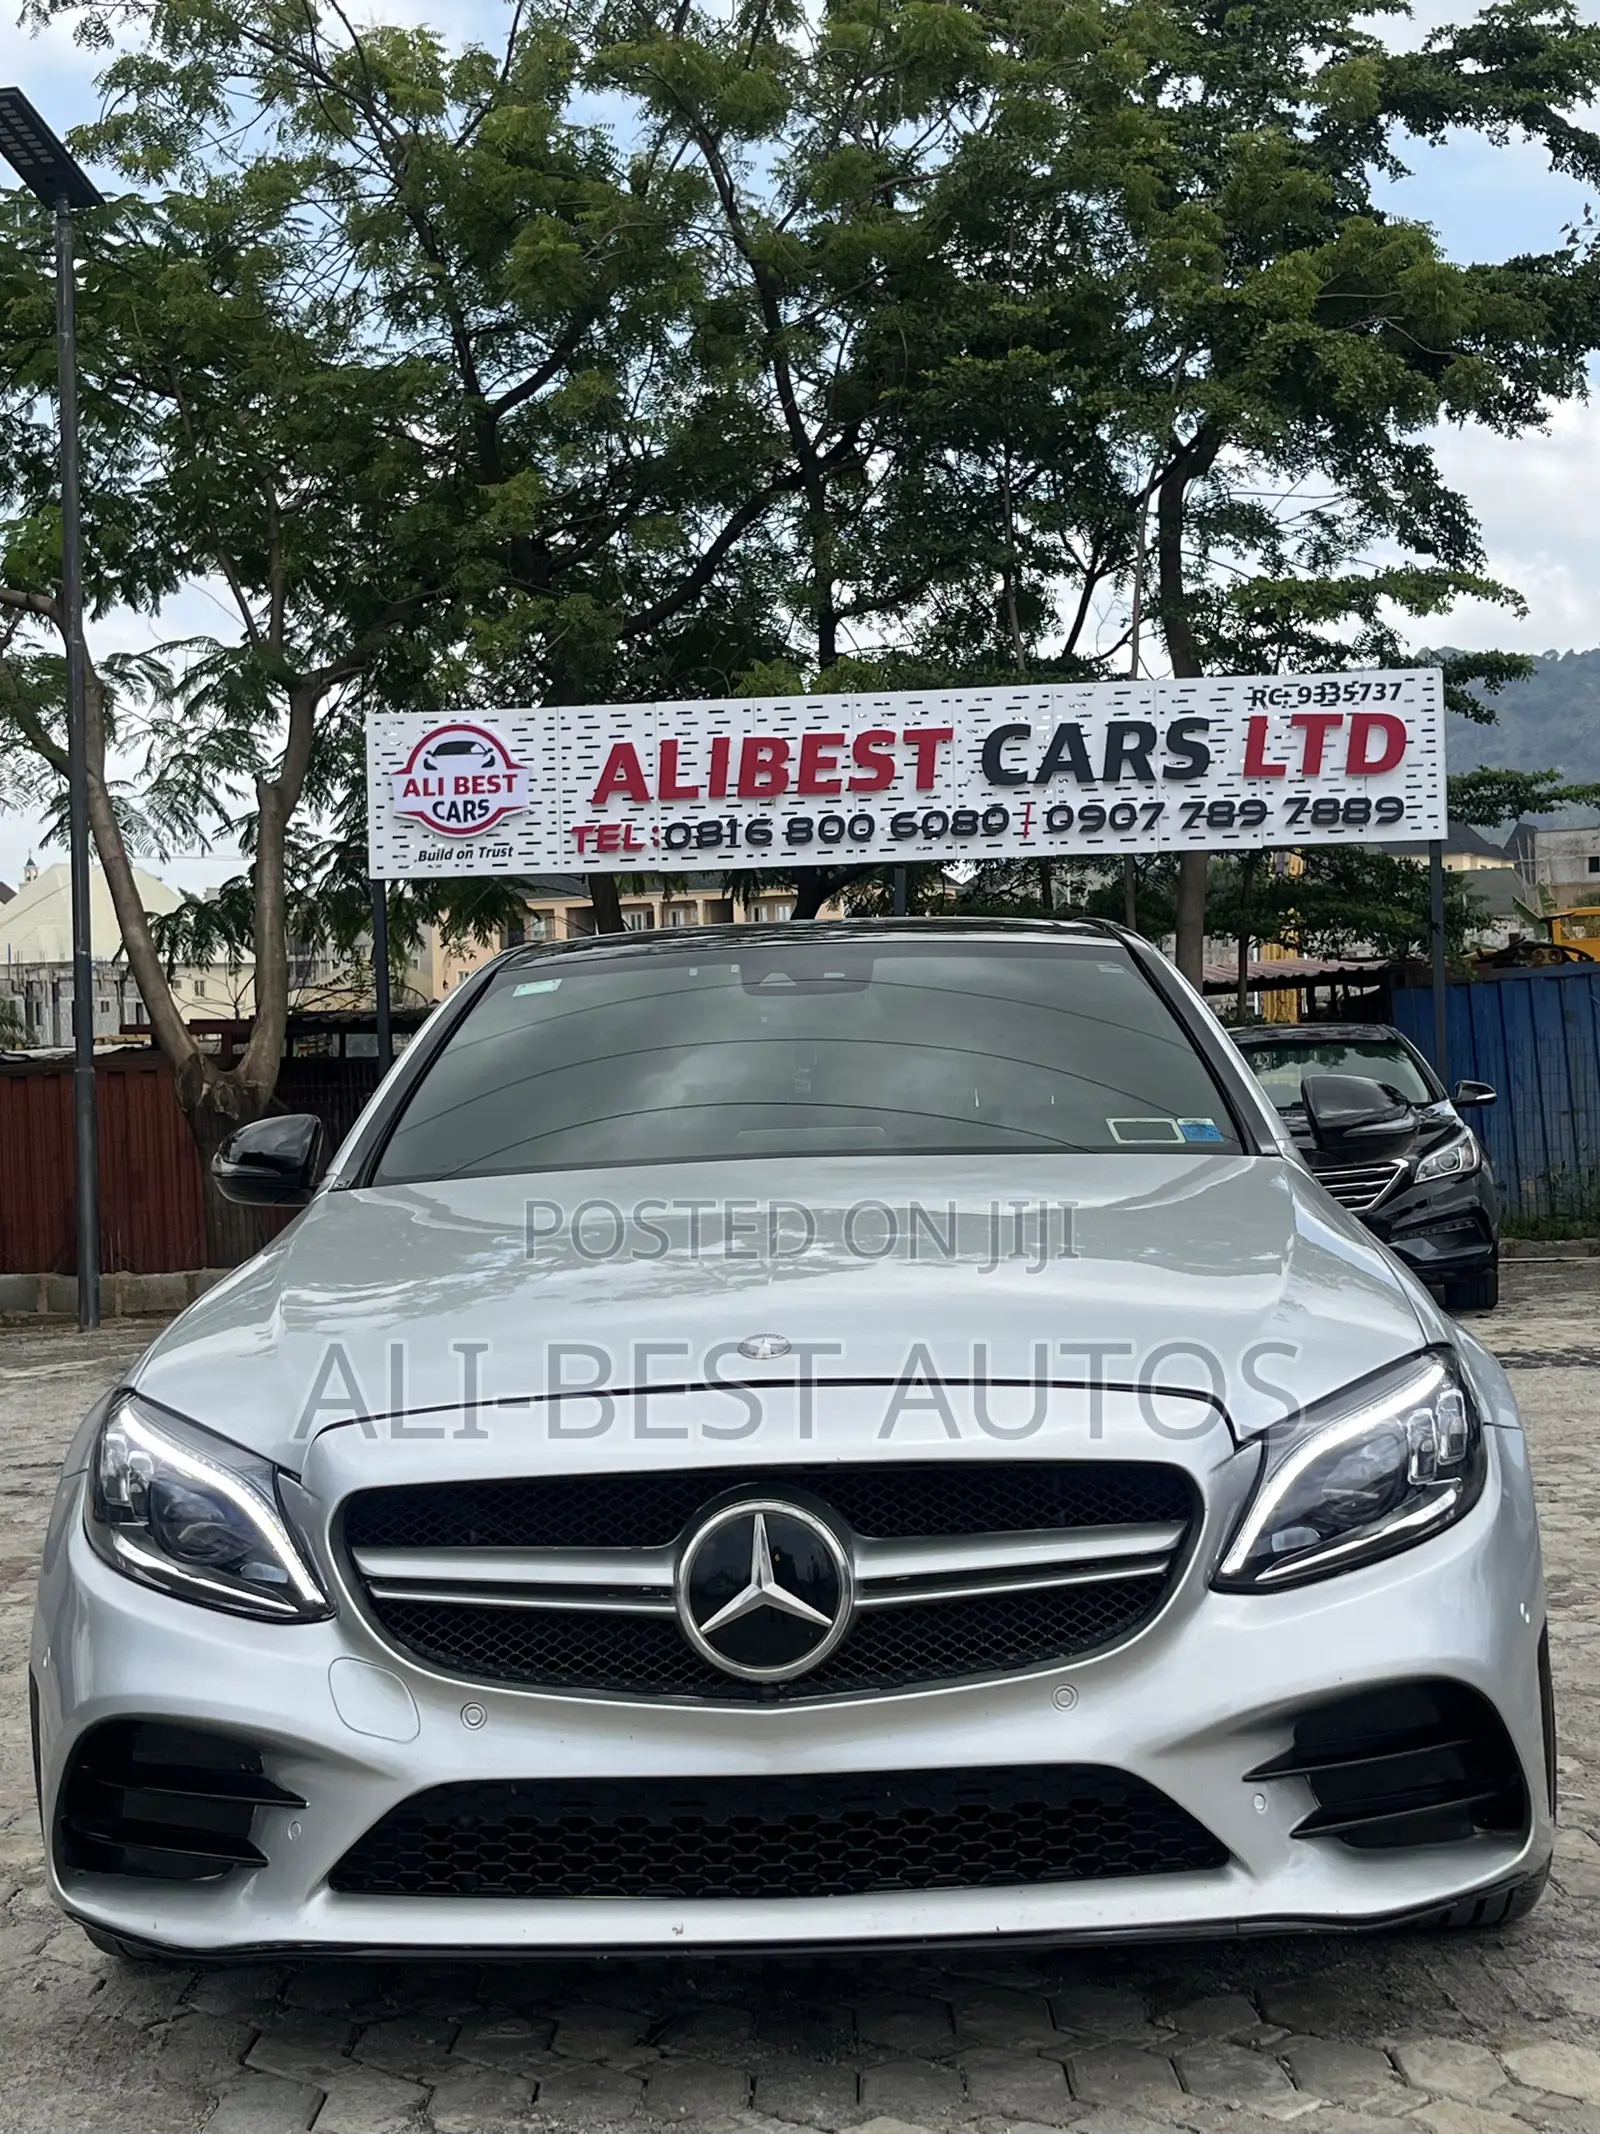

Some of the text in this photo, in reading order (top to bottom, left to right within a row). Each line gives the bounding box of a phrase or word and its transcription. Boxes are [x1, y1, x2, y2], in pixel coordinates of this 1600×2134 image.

[591, 712, 1407, 804] ALIBEST CARS LTD
[402, 774, 518, 797] ALI BEST
[432, 799, 490, 823] CARS
[664, 818, 773, 850] 0816
[787, 813, 876, 846] 800
[890, 807, 1010, 840] 6080
[1045, 801, 1165, 833] 0907
[1180, 799, 1268, 830] 789
[1282, 796, 1405, 826] 7889
[418, 846, 513, 862] Build on Trust
